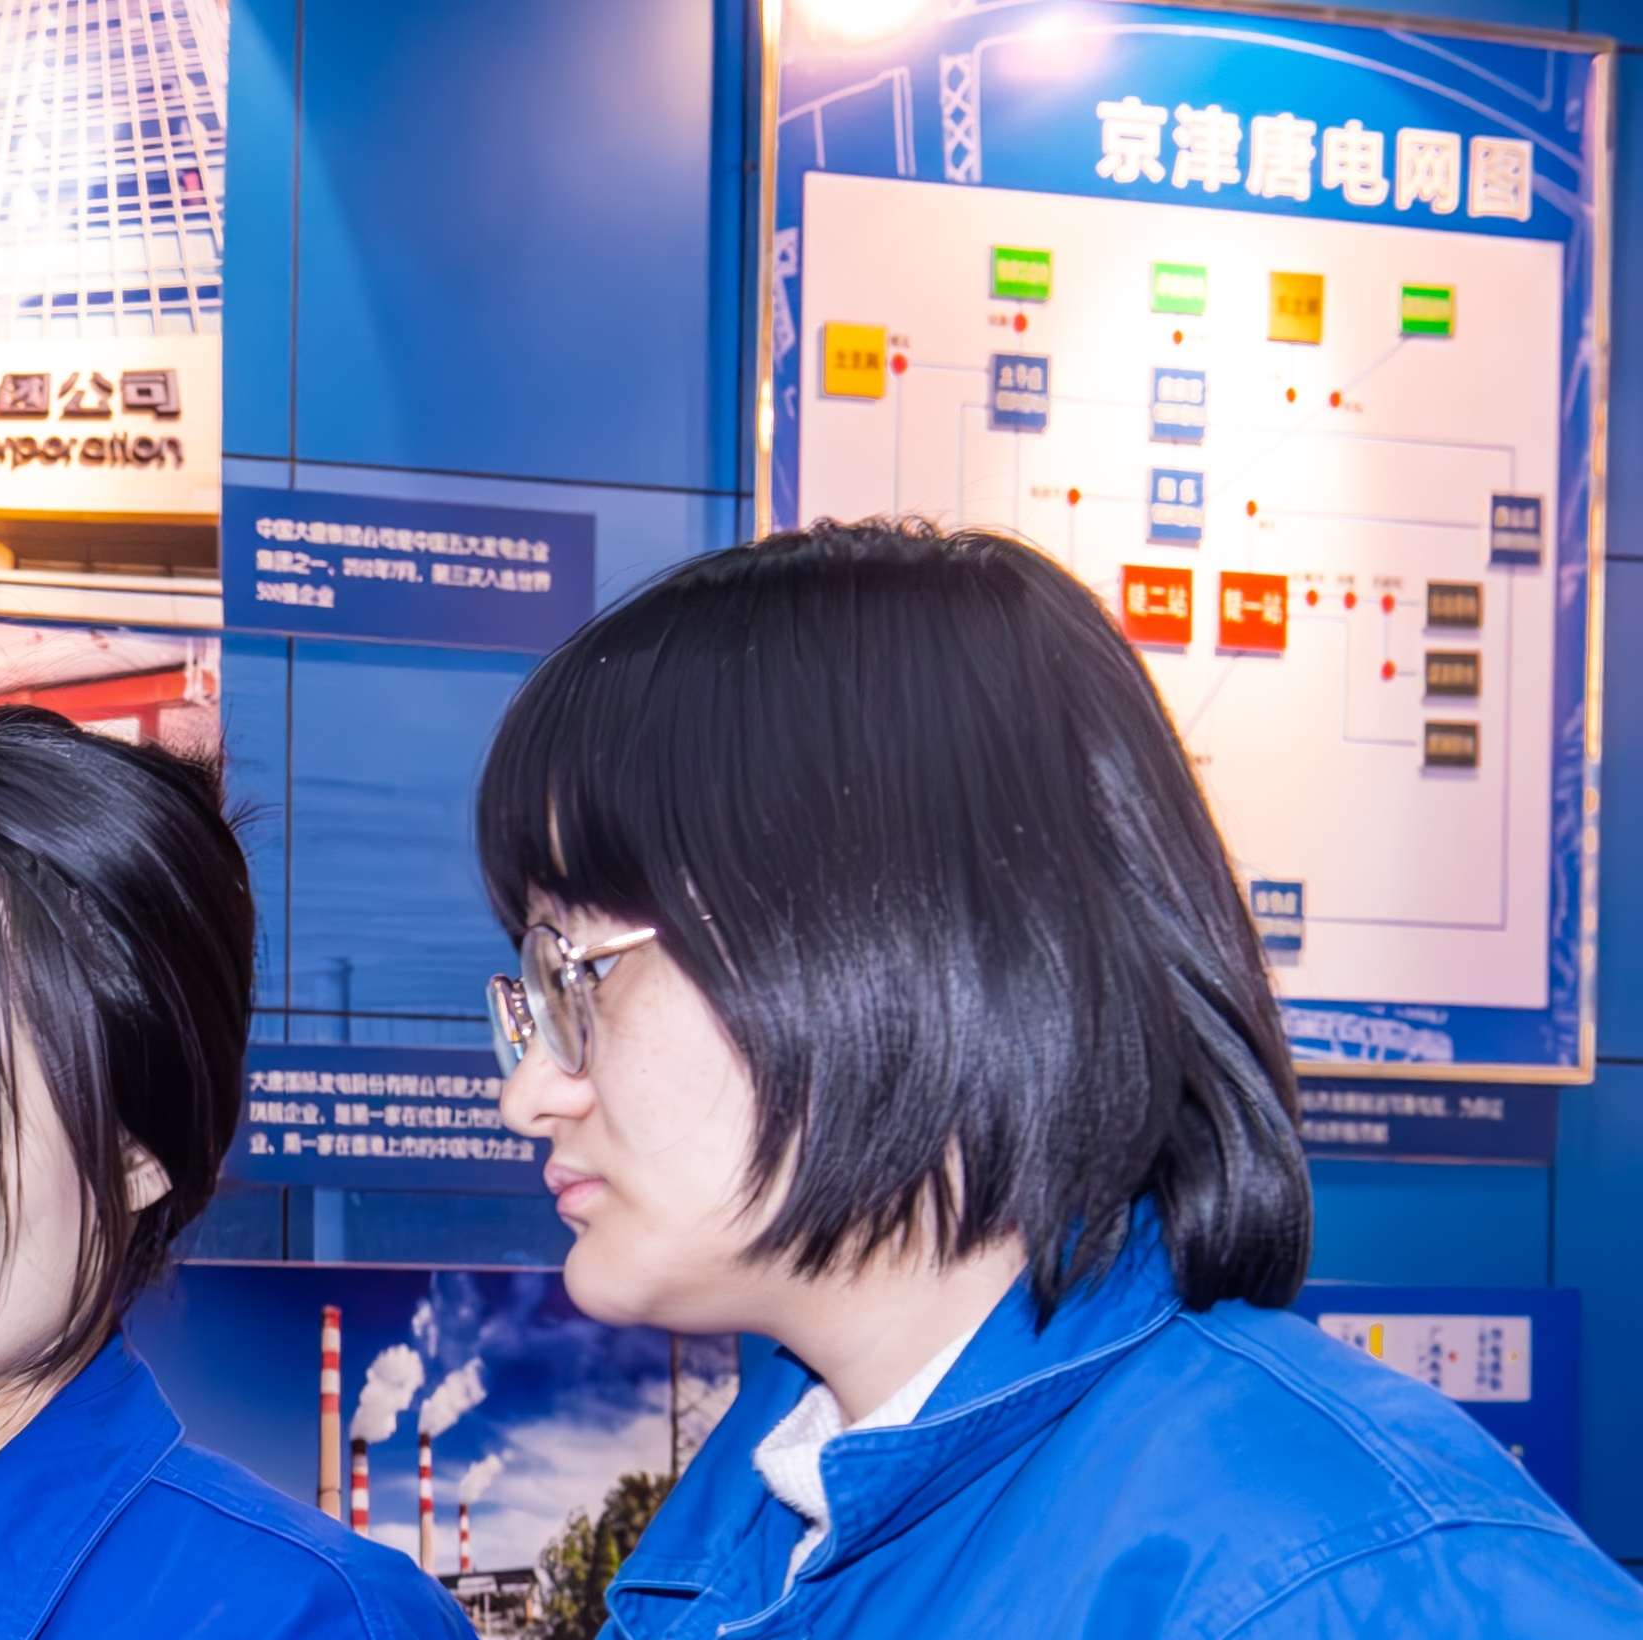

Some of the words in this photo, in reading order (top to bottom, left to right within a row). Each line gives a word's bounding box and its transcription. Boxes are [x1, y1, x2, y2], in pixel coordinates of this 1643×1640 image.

[1095, 95, 1535, 221] 京津唐电网图
